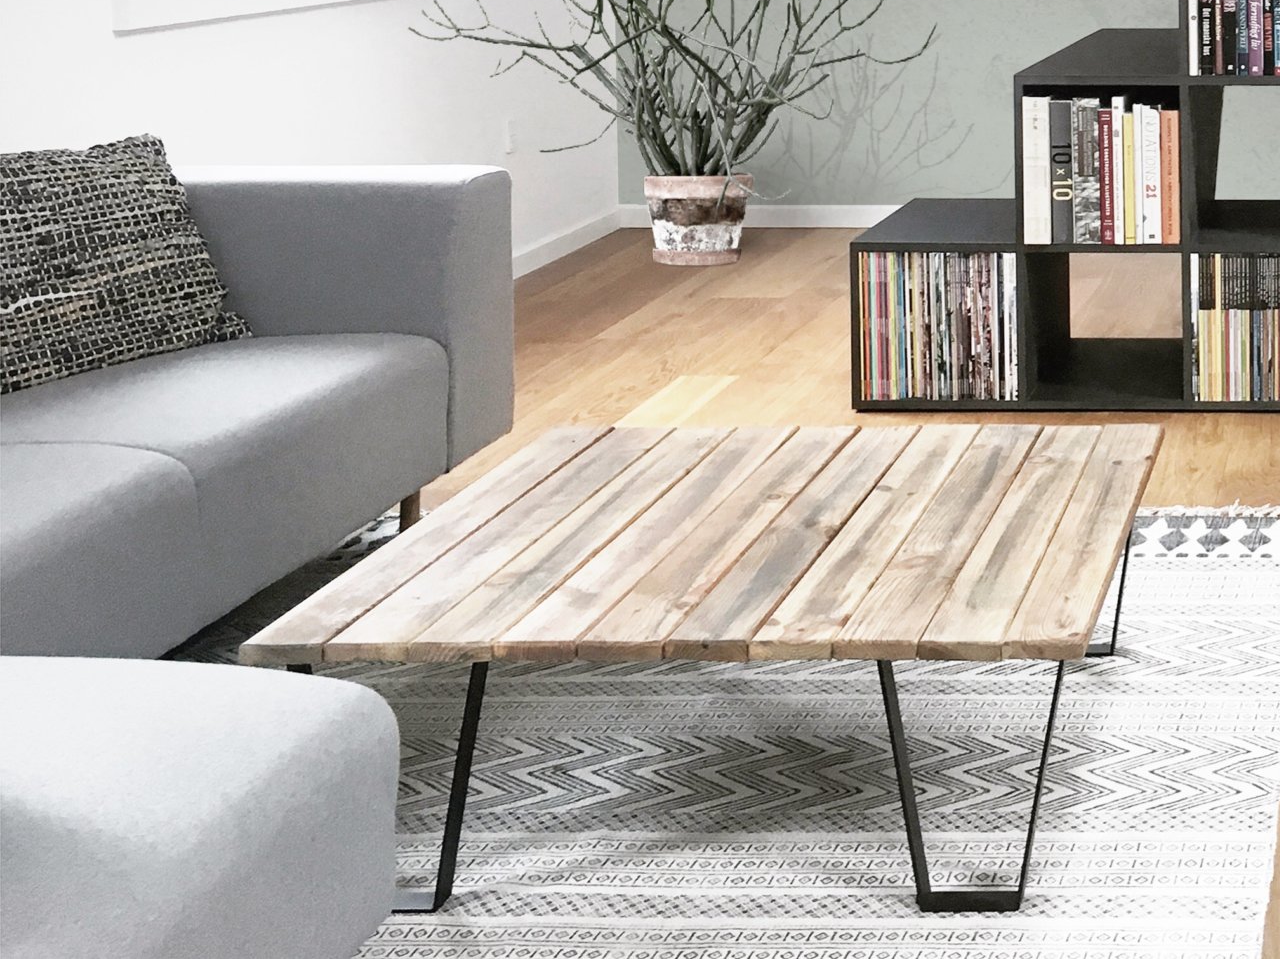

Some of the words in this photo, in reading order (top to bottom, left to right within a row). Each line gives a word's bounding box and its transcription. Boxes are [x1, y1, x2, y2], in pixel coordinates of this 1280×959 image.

[1202, 18, 1211, 44] romanske
[1202, 46, 1211, 55] hus
[1250, 39, 1261, 50] liv
[1052, 142, 1072, 164] 10
[1144, 115, 1156, 182] NOTATIONS
[1052, 178, 1072, 201] 10
[1146, 184, 1157, 198] 21
